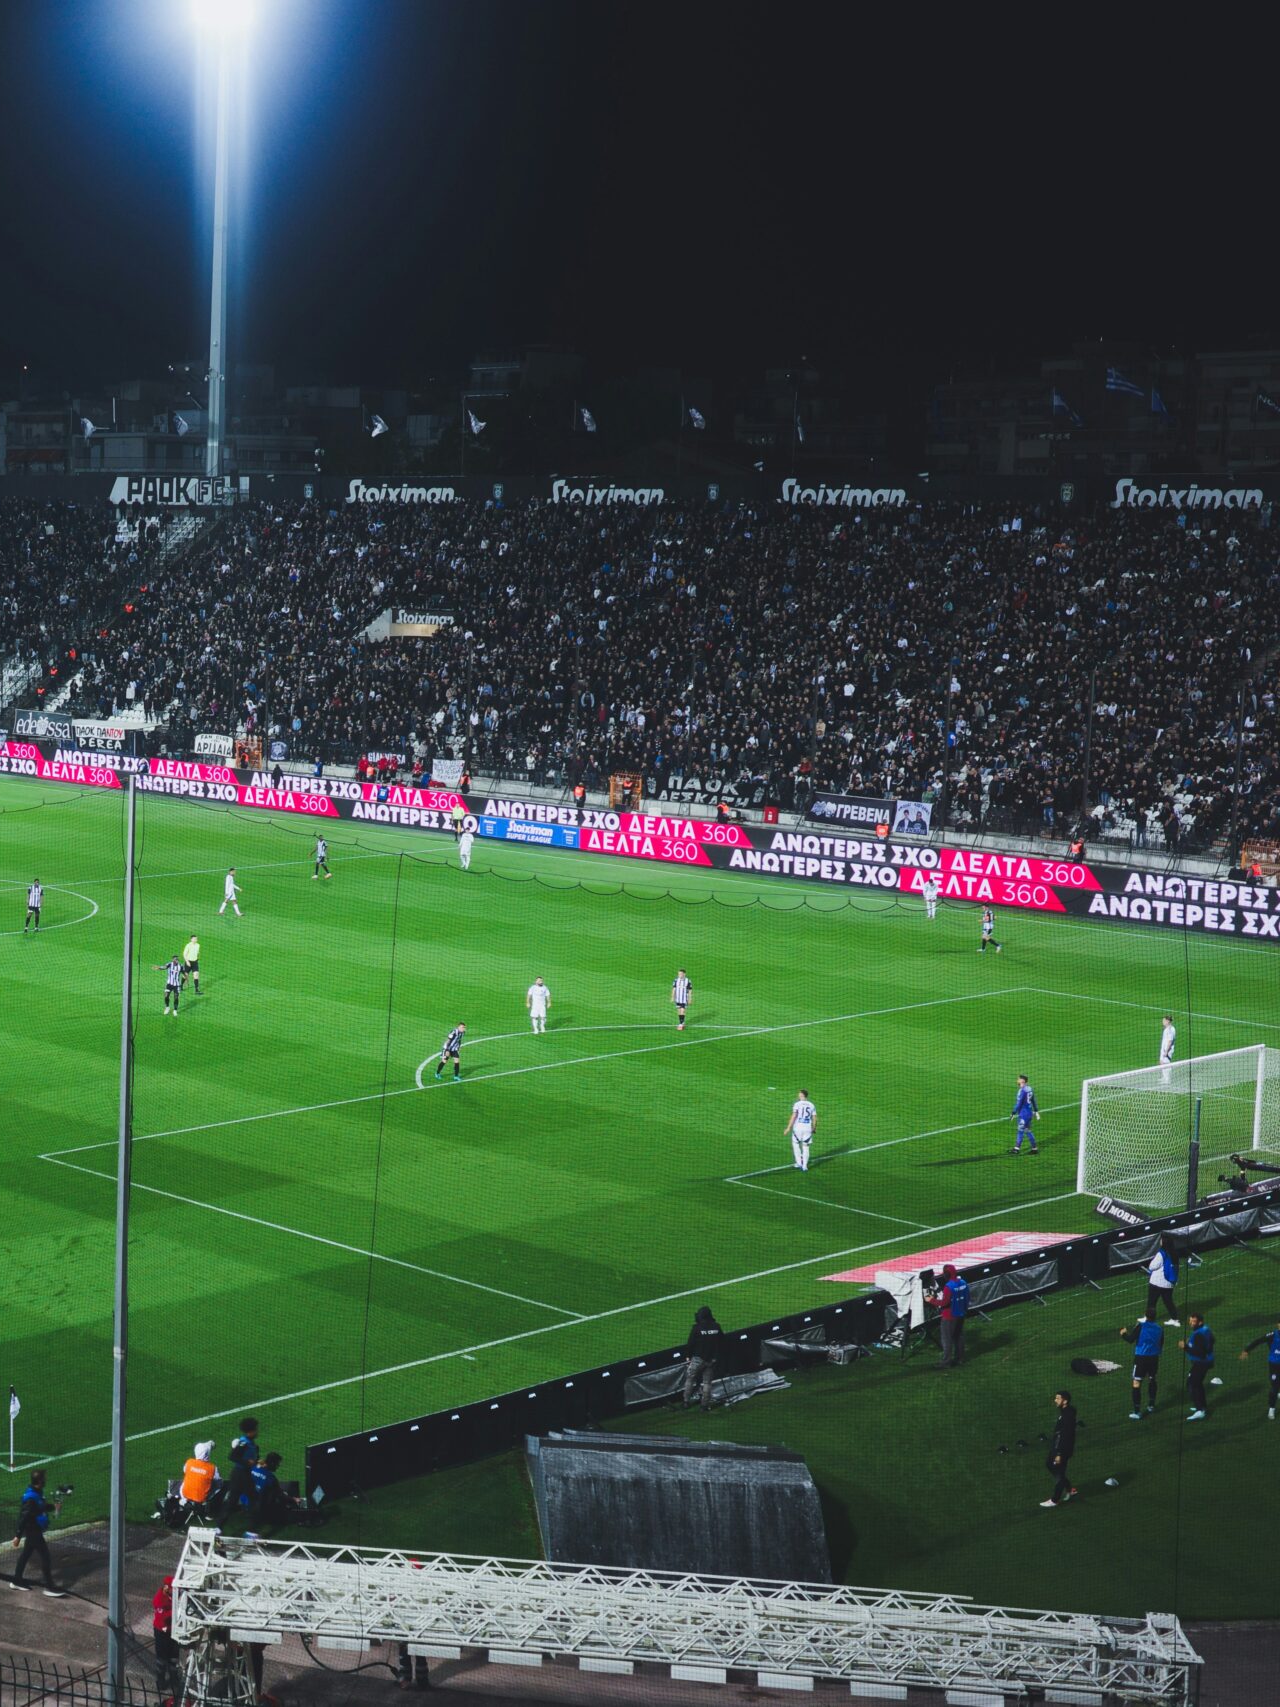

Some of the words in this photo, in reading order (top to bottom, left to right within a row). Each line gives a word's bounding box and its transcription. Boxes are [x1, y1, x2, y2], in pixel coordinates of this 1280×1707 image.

[128, 477, 193, 504] PAOK
[345, 479, 455, 504] Stoiximan
[550, 479, 664, 506] Stoiximan
[781, 478, 906, 508] Stoiximan
[1112, 478, 1264, 510] Stoiximan
[396, 609, 455, 625] Stoiximan
[13, 743, 35, 759] 360
[54, 749, 121, 771] ΑΝΩΤΕΡΕΣ
[10, 758, 38, 776] ΣΧΟ
[42, 762, 86, 782] ΔΕΛΤΑ
[89, 769, 113, 785] 360
[156, 760, 202, 779] ΔΕΛΤΑ
[205, 767, 231, 783] 360
[135, 773, 204, 798] ΑΝΩΤΕΡΕΣ
[207, 782, 239, 802] ΣΧΟ
[251, 772, 328, 796] ΑΝΤΕΡΕΣ
[330, 781, 364, 799] ΣΧΟ
[668, 775, 739, 796] ΠΑΟΚ
[244, 788, 296, 809] ΔΕΛΤΑ
[300, 794, 329, 813] 360
[428, 791, 459, 809] 360
[352, 802, 440, 827] ΑΝΩΤΕΡΕΣ
[484, 799, 579, 825] ΑΝΩΤΕΡΕΣ
[582, 810, 621, 832] ΣΧΟ
[835, 803, 890, 824] ΓΡΕΒΕΝΑ
[506, 820, 554, 837] Stoiximan
[506, 832, 526, 841] SUPER
[527, 834, 552, 844] LEAGUE
[629, 814, 696, 839] ΔΕΛΤΑ
[702, 822, 740, 844] 360
[587, 830, 655, 856] ΔΕΛΤΑ
[661, 839, 698, 861] 360
[770, 832, 886, 863] ΑΝΩΤΕΡΕΣ
[891, 845, 941, 870] ΣΧΟ
[729, 848, 846, 881] ΑΝΩΤΕΡΕΣ
[850, 863, 901, 889] ΣΧΟ
[950, 852, 1032, 880] ΔΕΛΤΑ
[1040, 861, 1086, 887] 360
[1002, 881, 1049, 906] 360
[1124, 872, 1270, 910] ΑΝΩΤΕΡΕΣ
[1088, 893, 1236, 932] ΑΝΩΤΕΡΕΣ
[1241, 911, 1280, 938] ΣΧ
